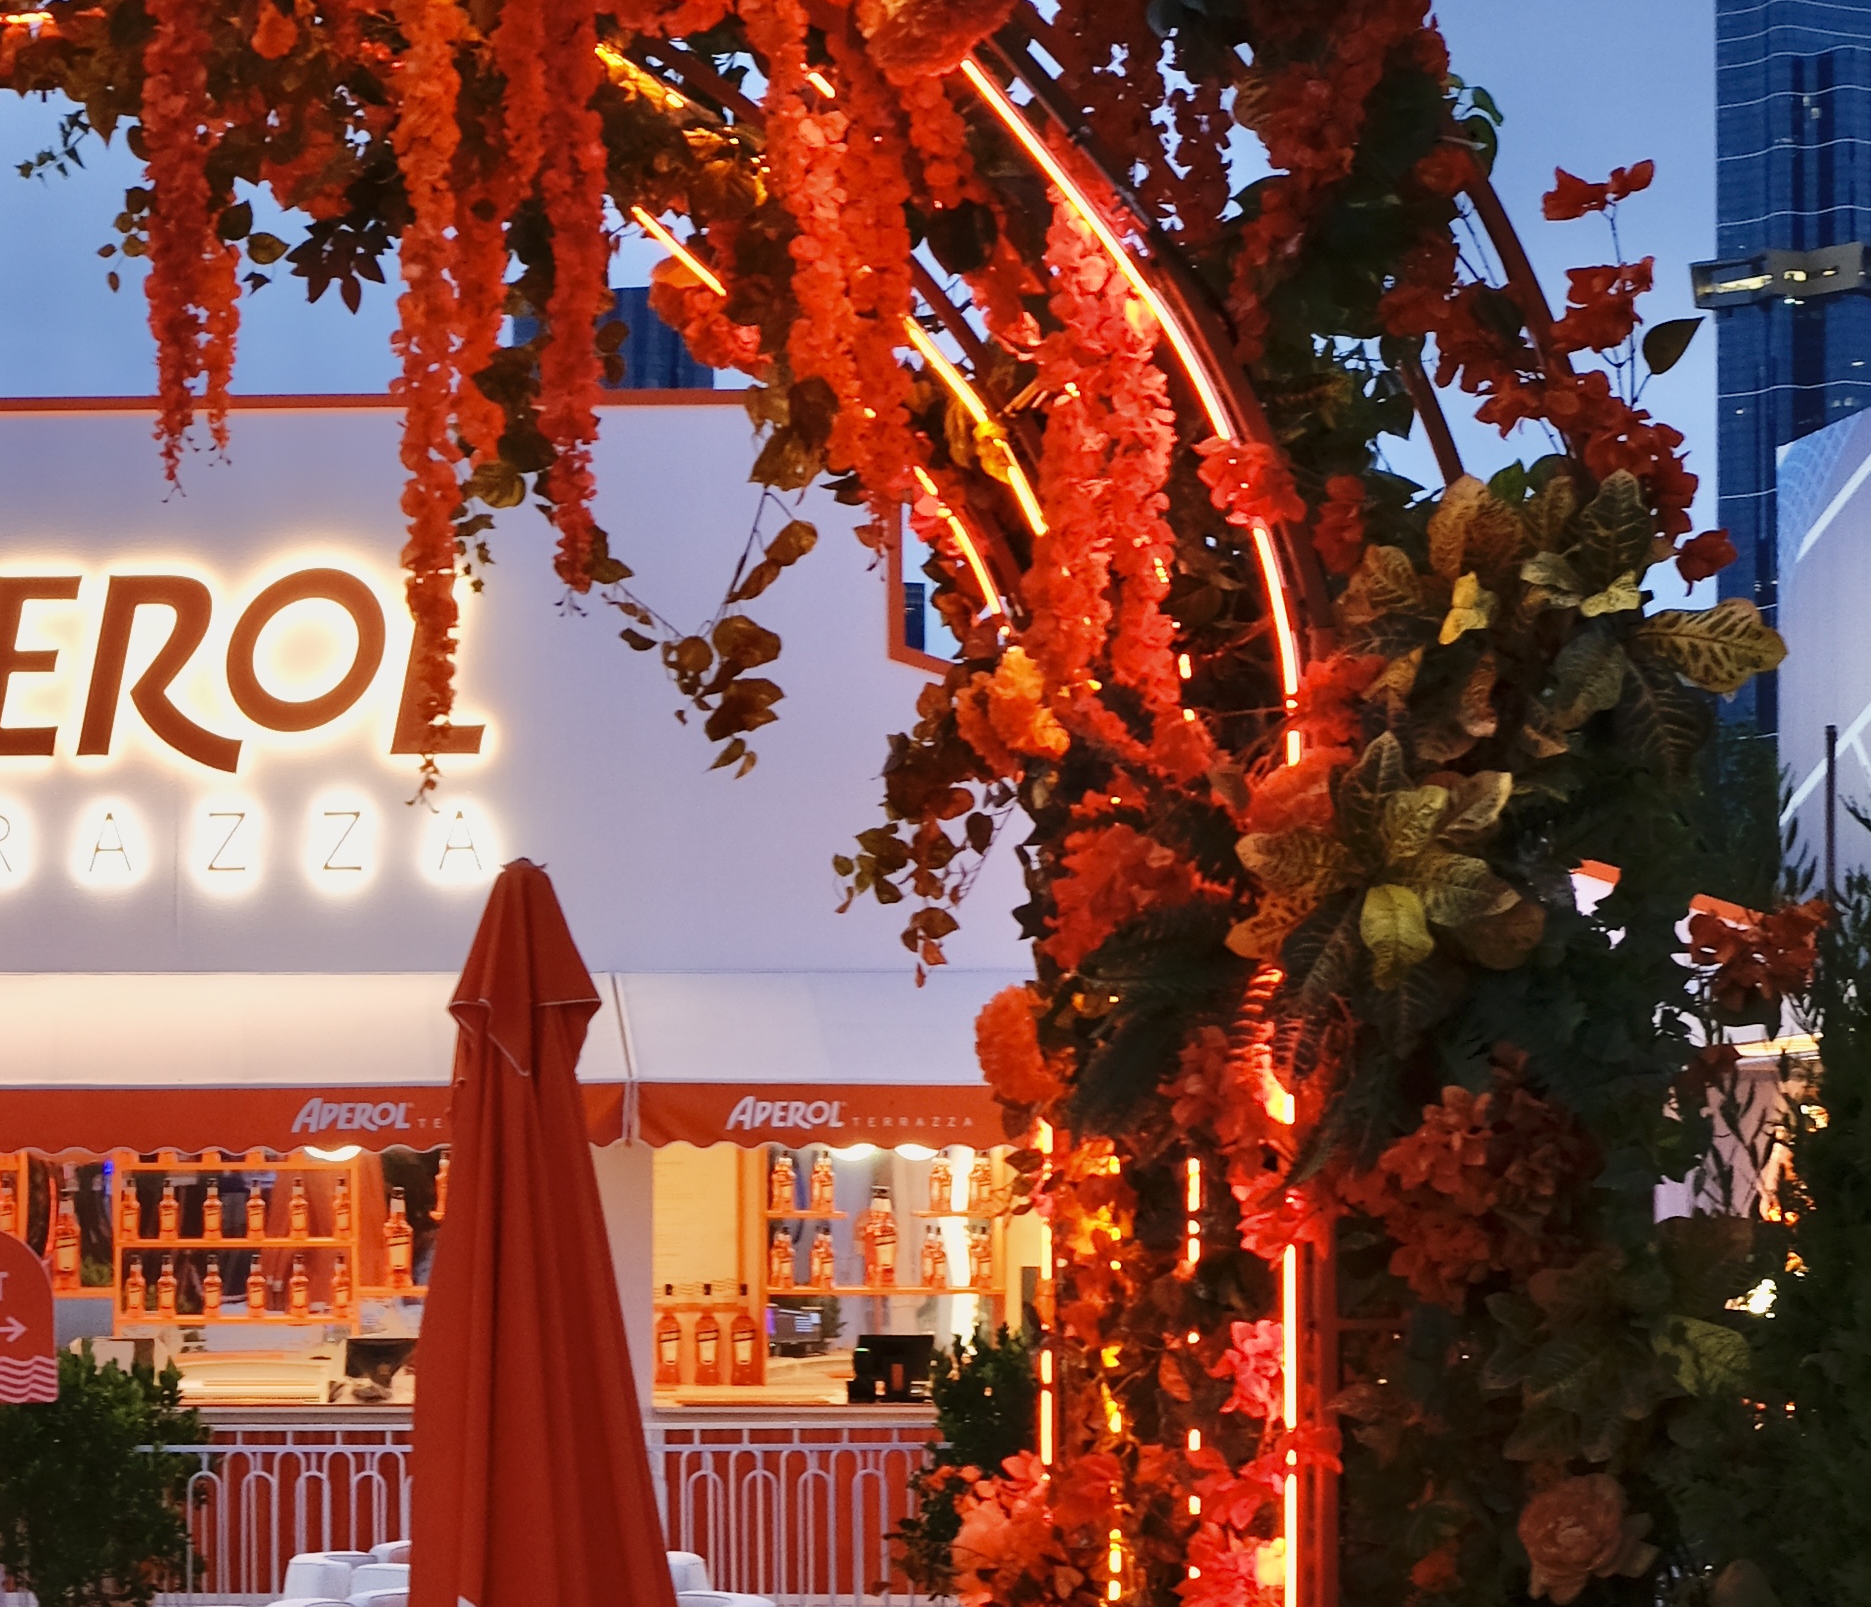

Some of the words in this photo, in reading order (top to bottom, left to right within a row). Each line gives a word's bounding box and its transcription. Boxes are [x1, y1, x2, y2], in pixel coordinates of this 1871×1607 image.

[291, 1097, 411, 1133] APEROL
[725, 1096, 845, 1130] APEROL
[852, 1116, 974, 1128] TERRAZZA
